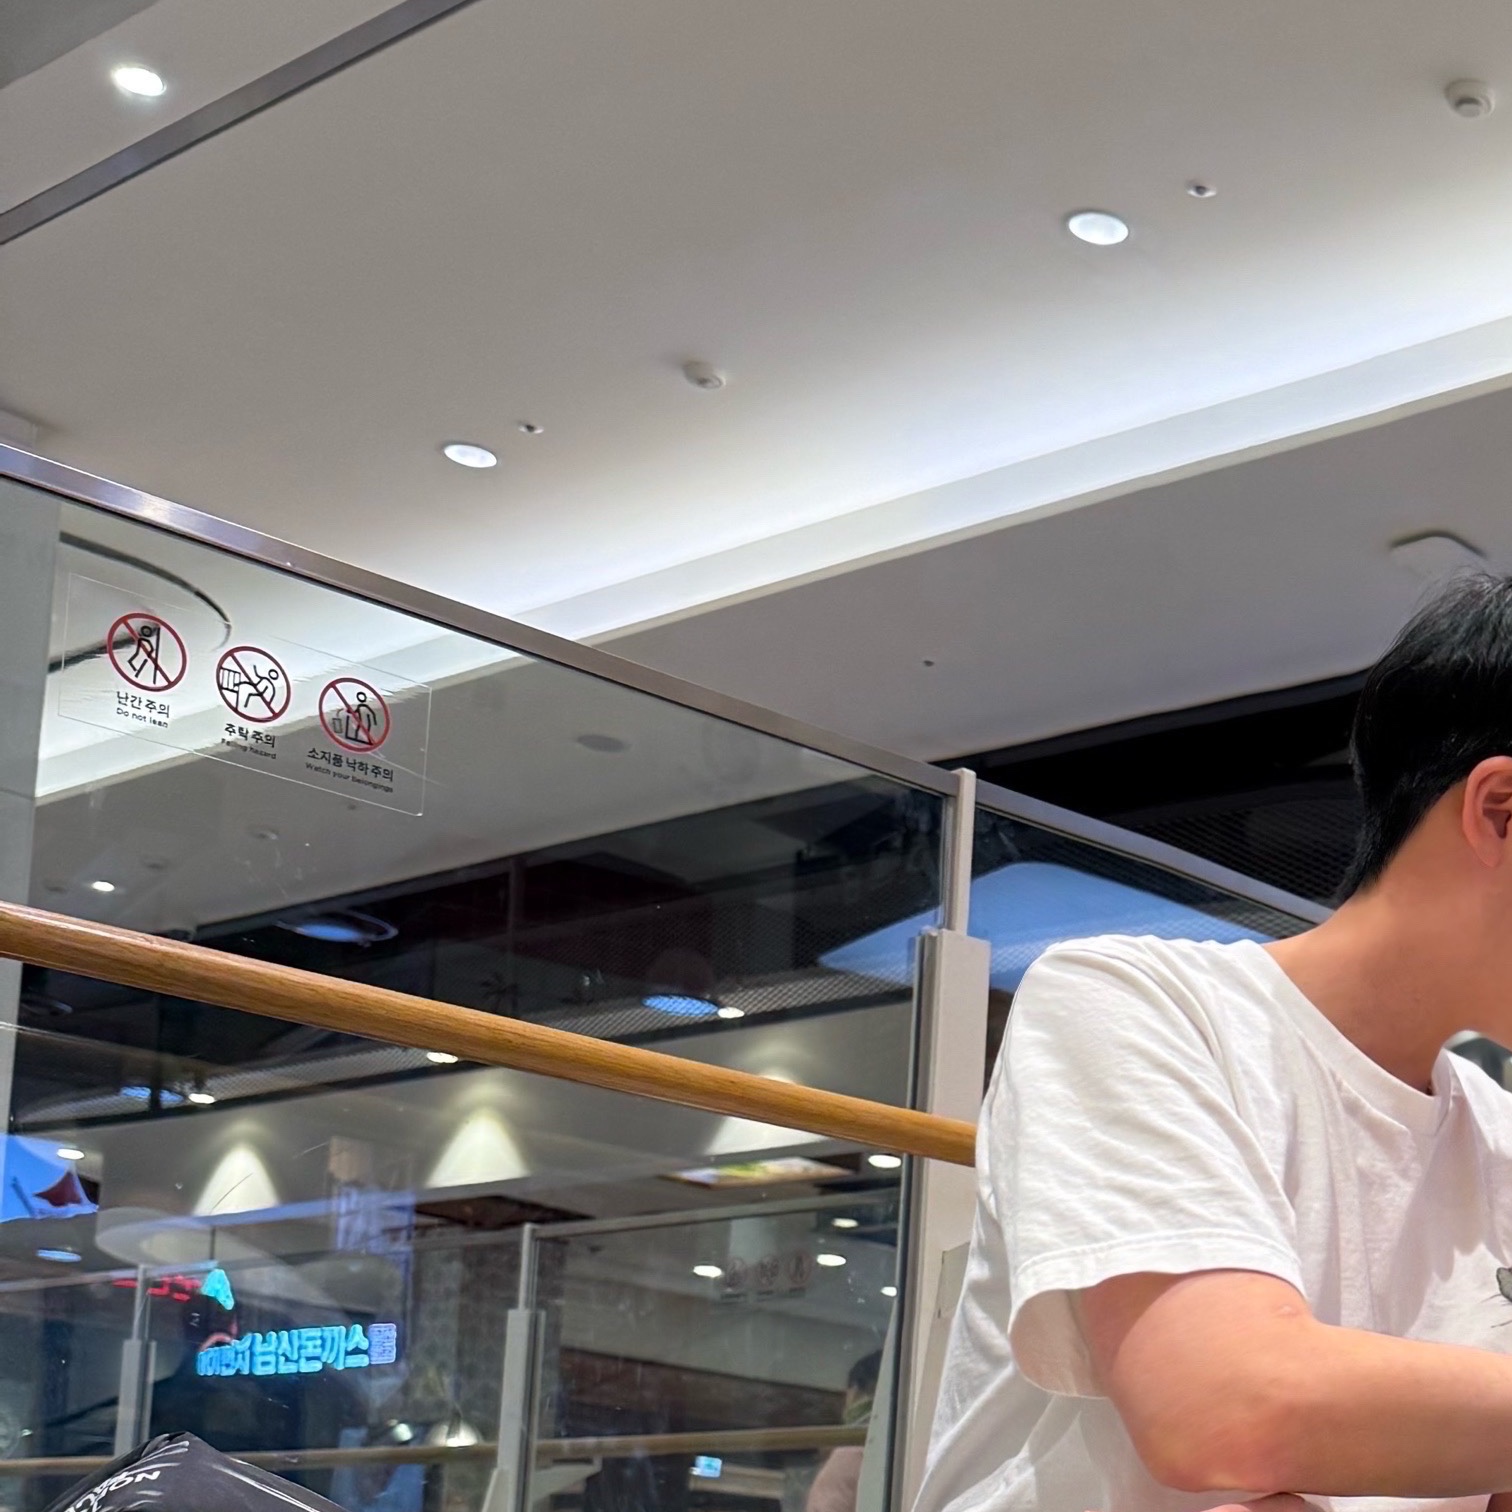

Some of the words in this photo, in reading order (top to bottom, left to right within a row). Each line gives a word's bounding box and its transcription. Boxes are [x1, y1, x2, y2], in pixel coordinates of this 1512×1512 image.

[116, 690, 142, 710] 난간
[145, 699, 170, 719] 주의
[116, 707, 129, 717] Do
[132, 713, 147, 723] not
[150, 716, 169, 729] lean
[251, 730, 276, 749] 주의
[307, 747, 343, 768] 소지품
[346, 757, 369, 776] 낙하
[371, 764, 394, 782] 주의
[251, 1323, 370, 1377] 남산돈까스
